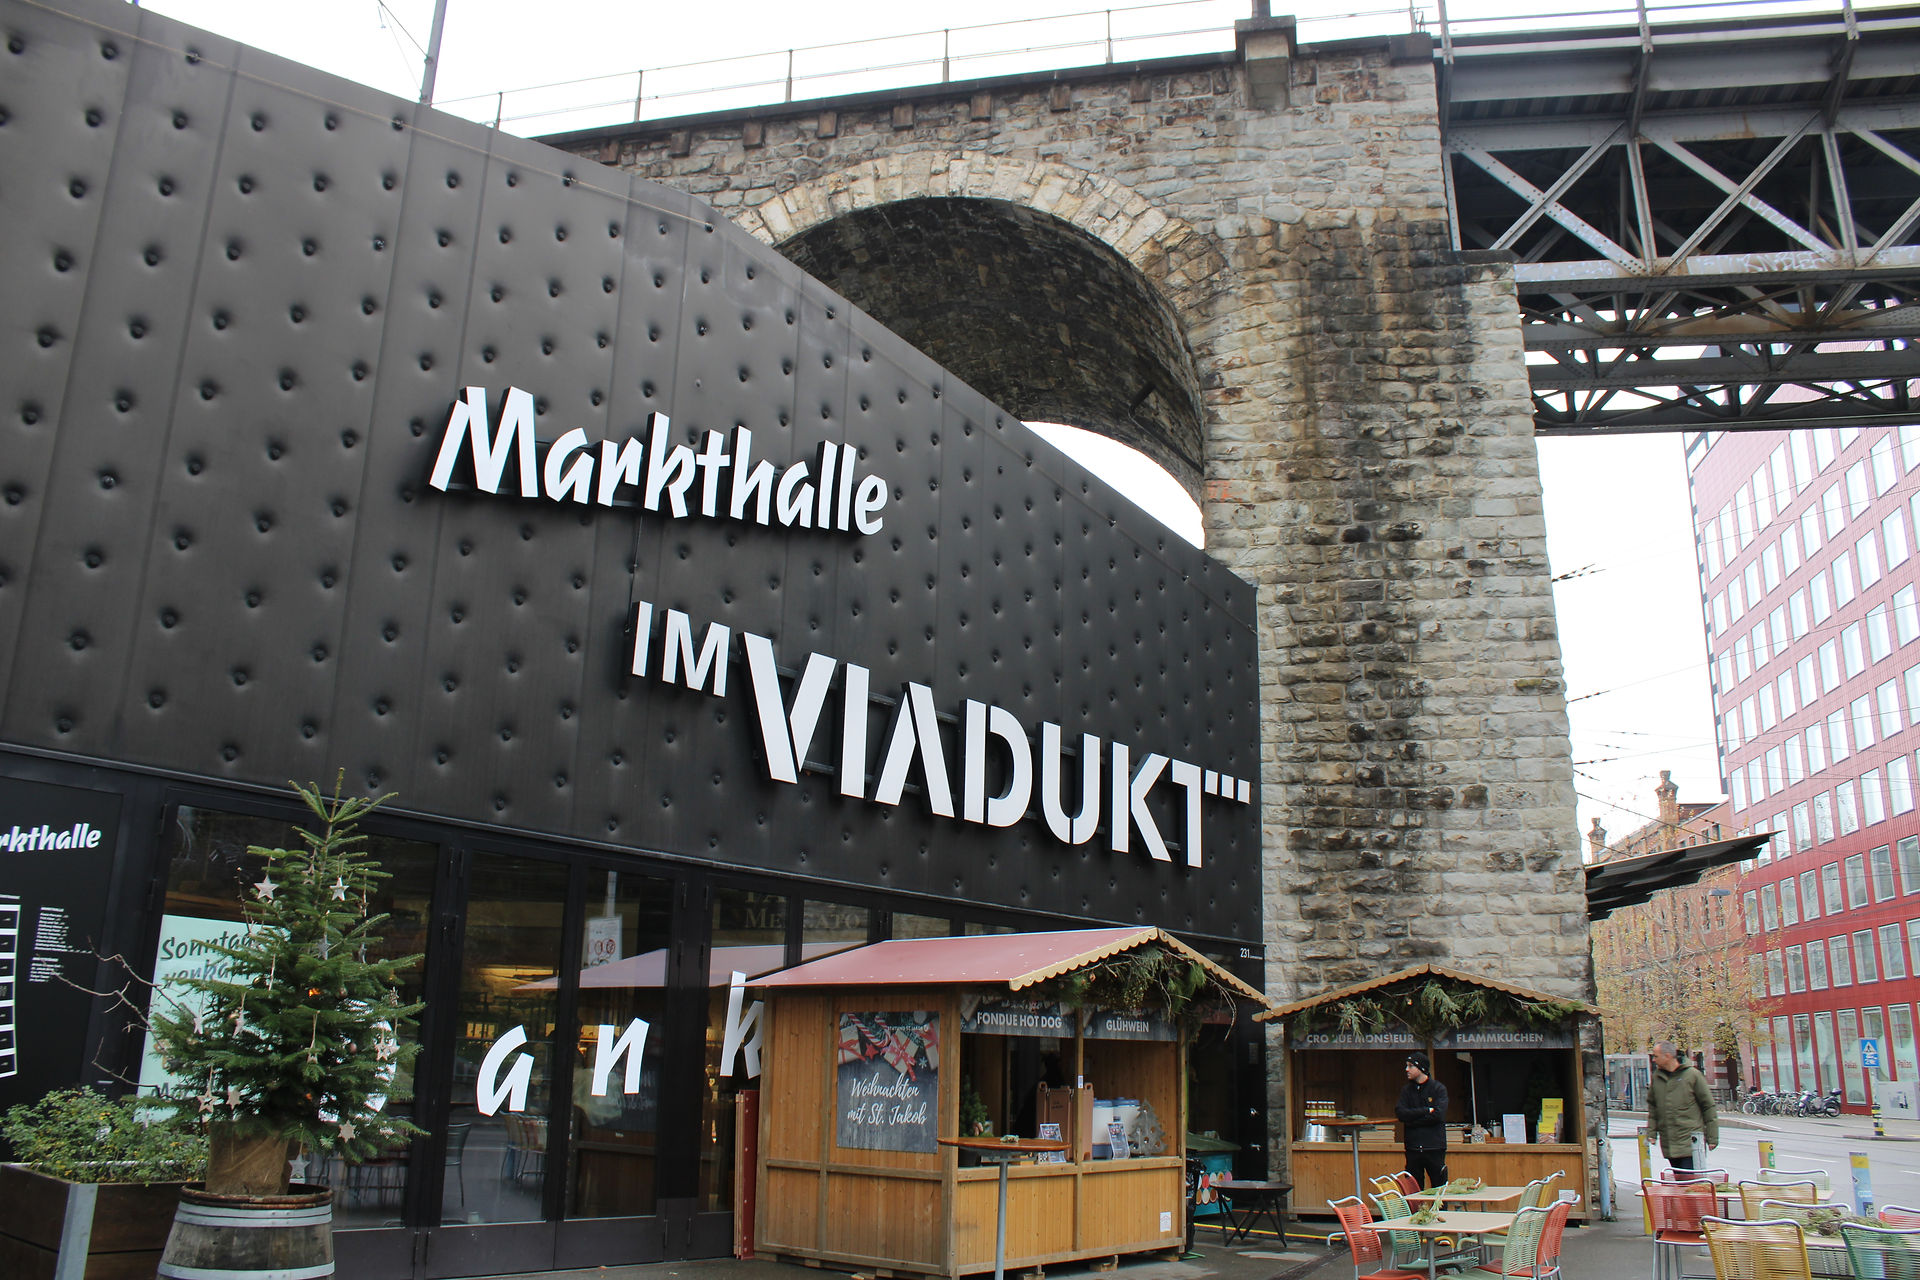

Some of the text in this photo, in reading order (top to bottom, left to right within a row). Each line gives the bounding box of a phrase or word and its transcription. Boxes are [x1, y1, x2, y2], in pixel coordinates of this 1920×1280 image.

[429, 386, 888, 536] Markthalle
[631, 600, 731, 698] IM
[1240, 947, 1250, 959] 231
[977, 1011, 1063, 1029] FONDUE HOT DOG
[1106, 1017, 1149, 1033] GLÜHWEIN
[1456, 1033, 1544, 1043] FLAMMKUCHEN
[851, 1073, 920, 1100] Weihnachten
[847, 1101, 928, 1126] mit St. Jakob
